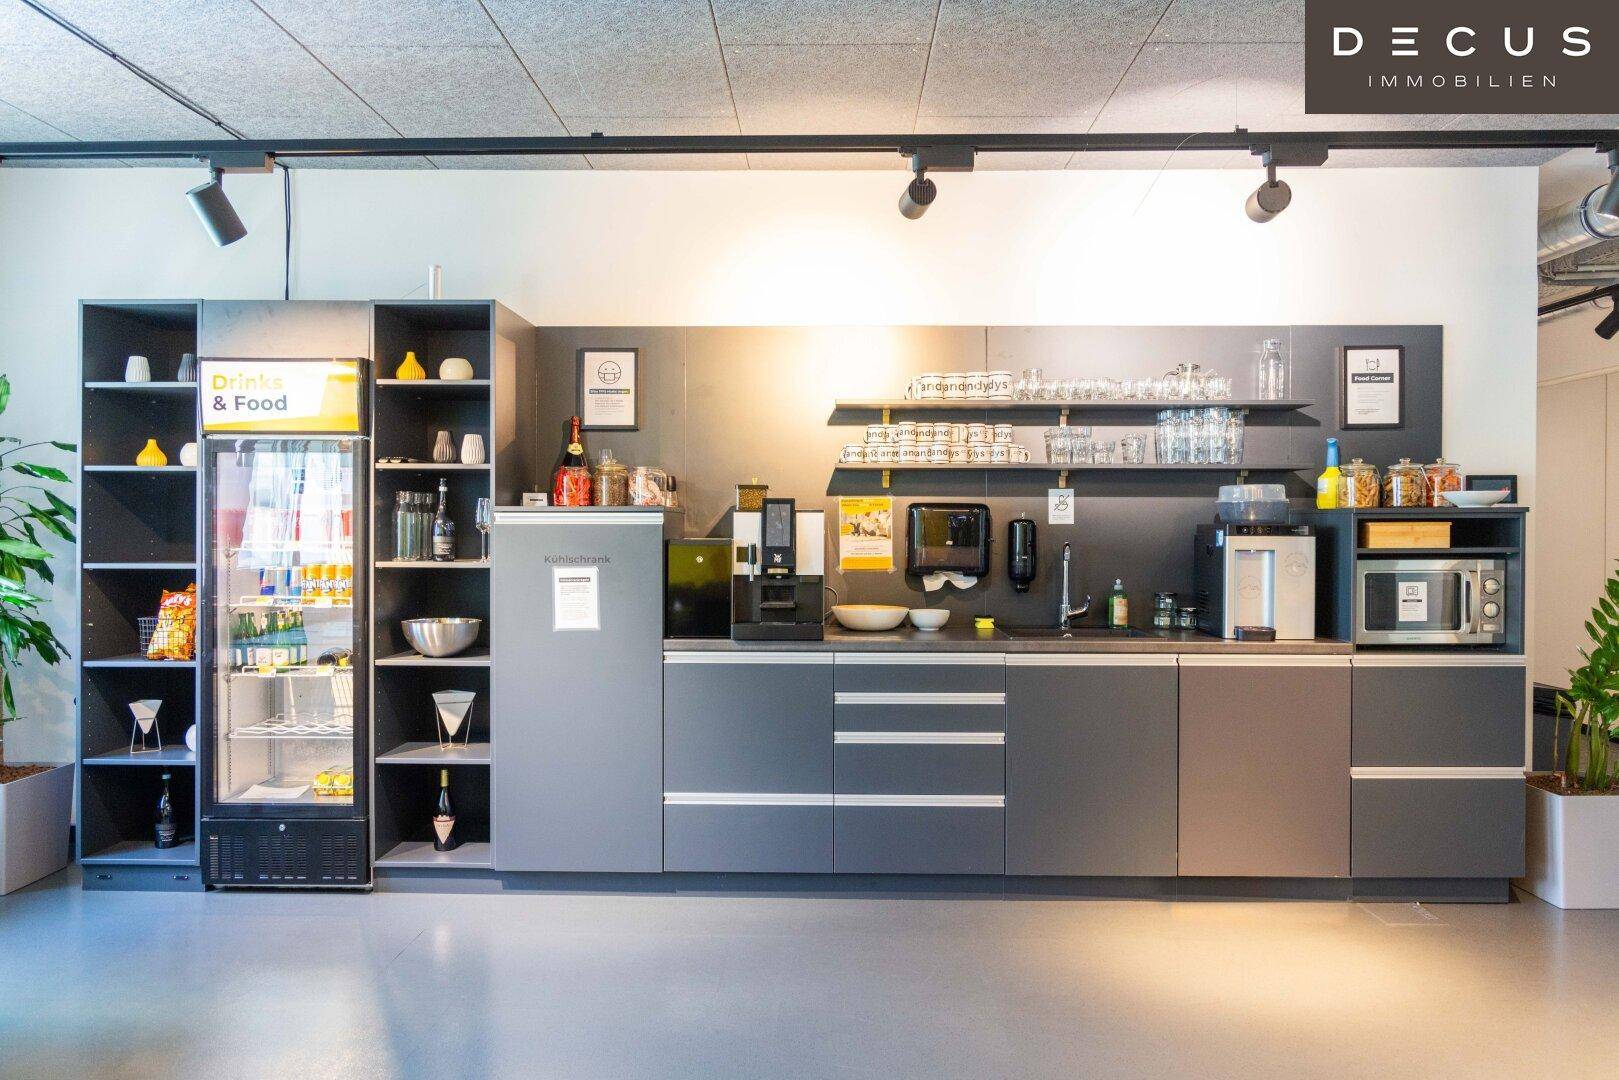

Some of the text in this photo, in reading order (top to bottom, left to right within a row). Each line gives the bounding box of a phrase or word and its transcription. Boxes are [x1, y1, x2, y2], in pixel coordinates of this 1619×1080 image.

[212, 372, 283, 390] Drinks
[212, 395, 288, 411] & Food
[544, 554, 611, 564] Kühlschrank
